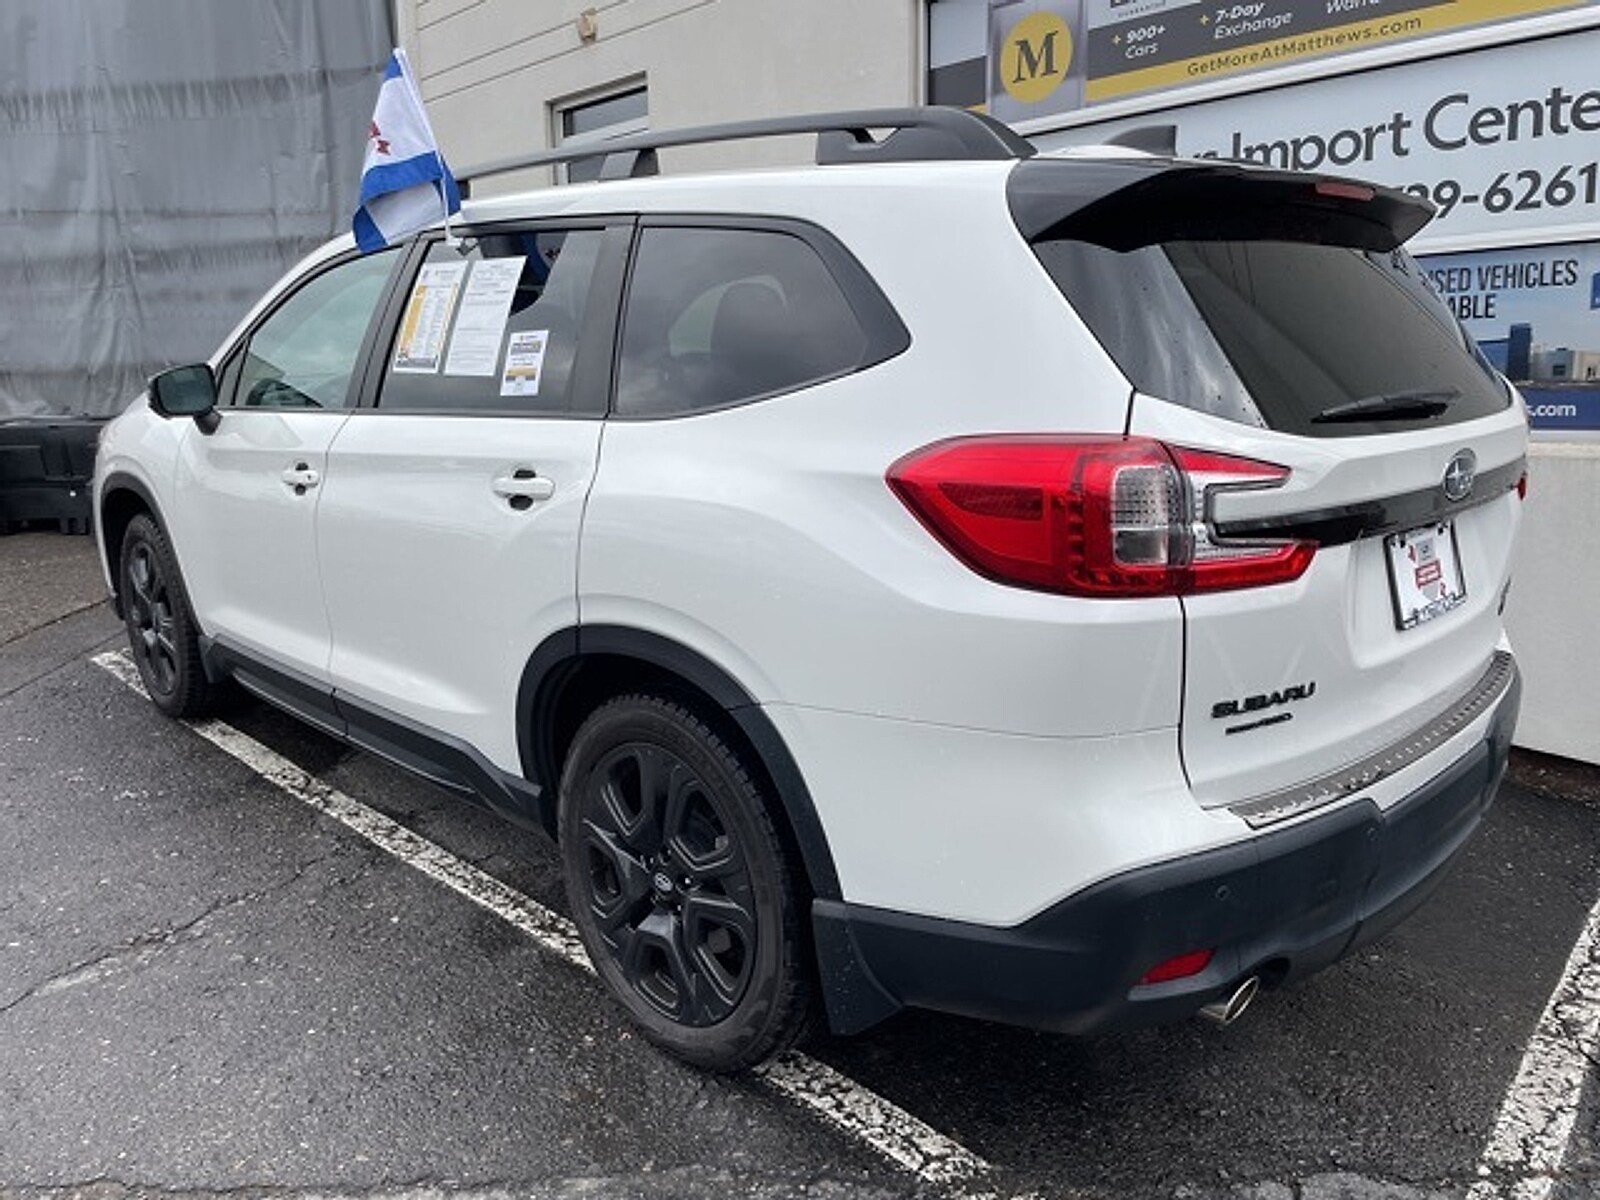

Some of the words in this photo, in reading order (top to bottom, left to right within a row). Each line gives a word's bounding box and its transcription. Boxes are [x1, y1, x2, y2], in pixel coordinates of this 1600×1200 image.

[1215, 2, 1265, 24] 7-Day
[1215, 12, 1292, 39] Exchange
[1125, 42, 1158, 59] Cars
[1126, 25, 1166, 44] 900+
[1187, 17, 1422, 76] GetMoreAtMatthews.com
[1012, 30, 1059, 83] M
[1232, 112, 1412, 171] Import
[1477, 259, 1579, 291] VEHICLES
[1211, 681, 1316, 718] SUBARU
